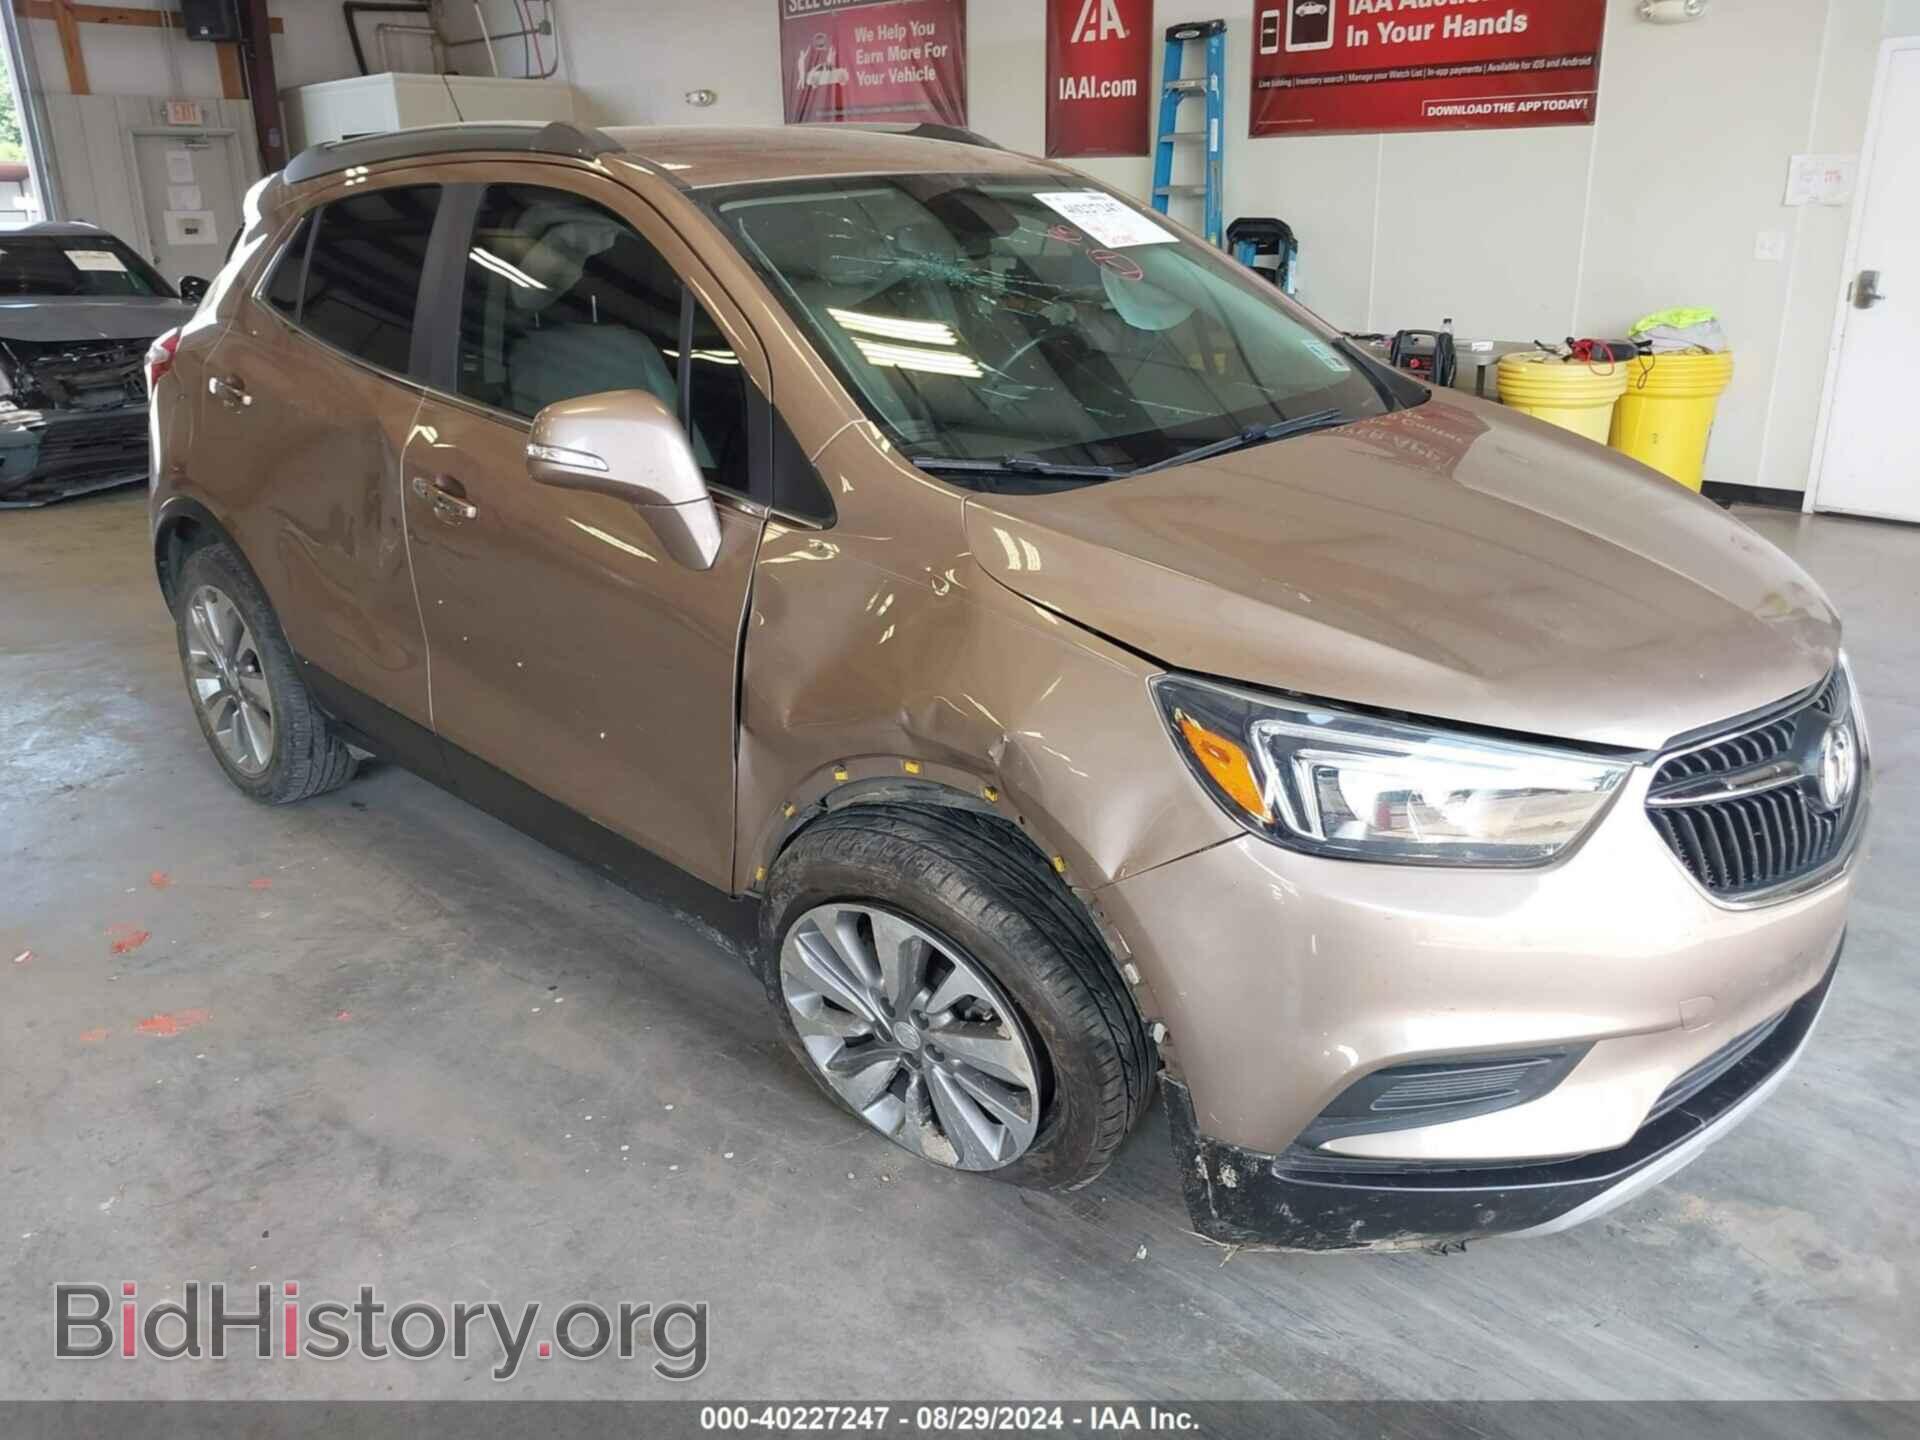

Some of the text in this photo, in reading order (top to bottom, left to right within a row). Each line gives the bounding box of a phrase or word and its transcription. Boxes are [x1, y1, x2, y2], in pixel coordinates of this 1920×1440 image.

[854, 21, 935, 43] We Help You
[1346, 9, 1528, 47] In Your Hands
[855, 42, 948, 65] Earn More For
[856, 65, 936, 87] Your Vehicle
[1059, 75, 1137, 100] IAAI.com
[1427, 98, 1588, 116] DOWNLOAD THE APP TODAY!
